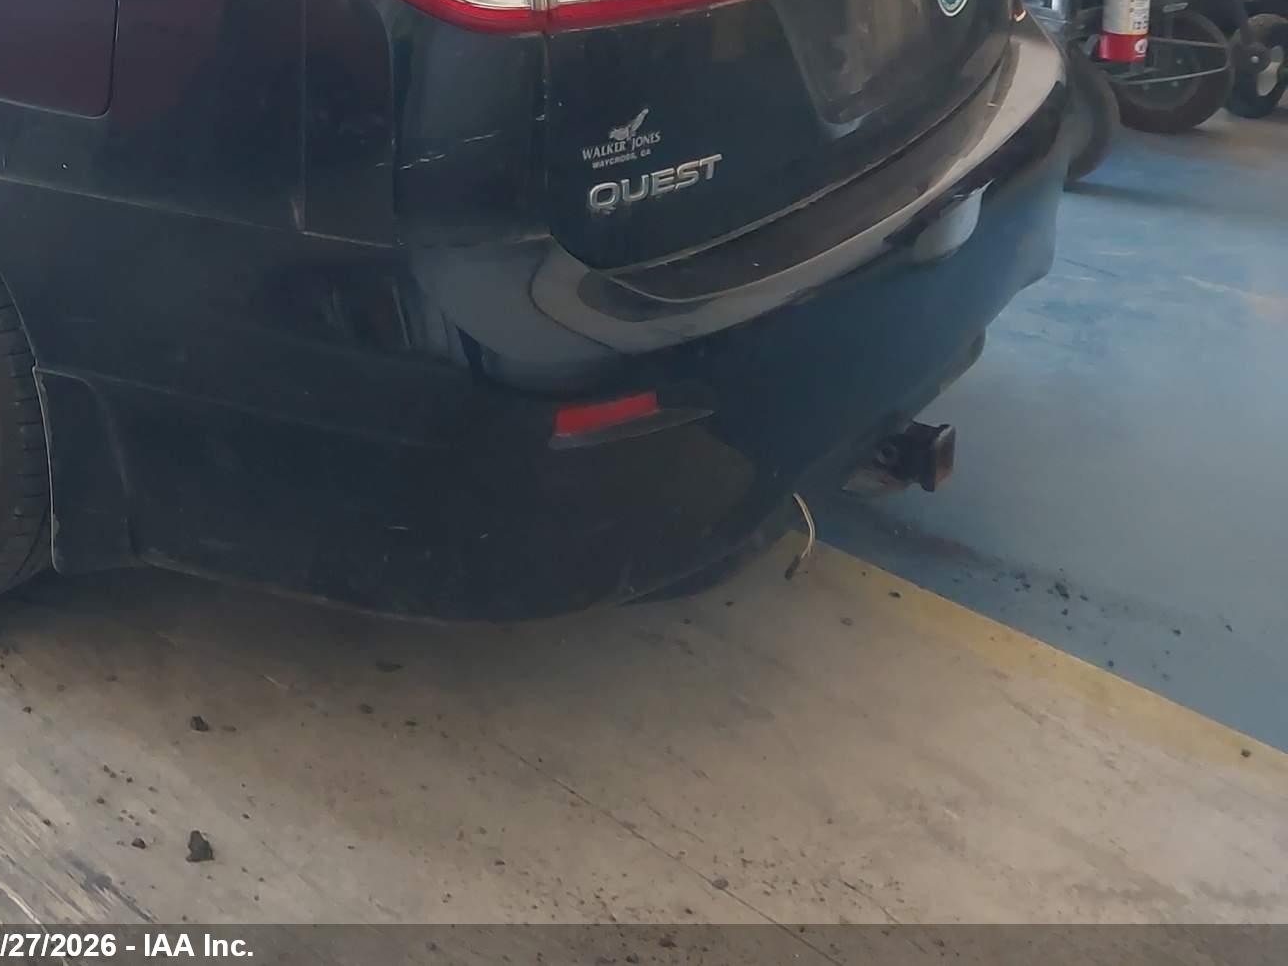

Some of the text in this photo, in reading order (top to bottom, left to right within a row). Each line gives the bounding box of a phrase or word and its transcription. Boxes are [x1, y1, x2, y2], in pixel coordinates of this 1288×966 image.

[581, 131, 661, 161] WALKER JONES
[588, 153, 722, 212] QUEST
